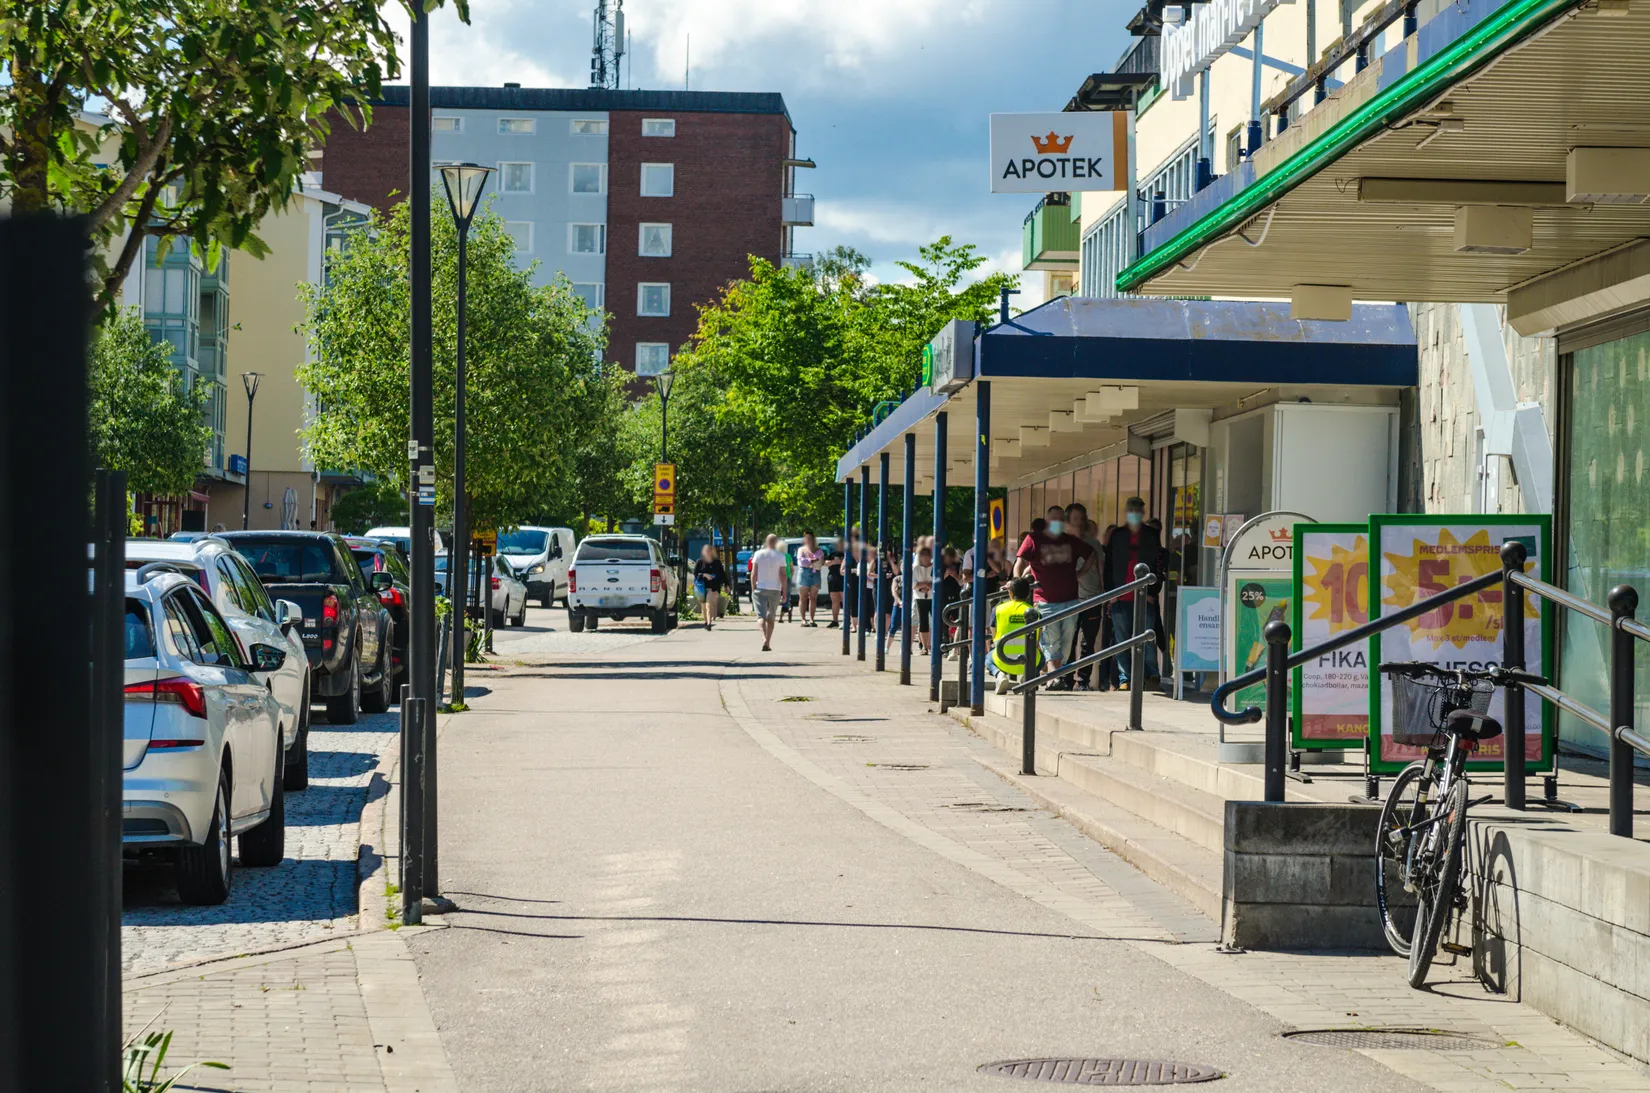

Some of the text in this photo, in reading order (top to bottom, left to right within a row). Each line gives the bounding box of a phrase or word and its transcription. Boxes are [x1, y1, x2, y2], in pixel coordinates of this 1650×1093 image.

[1003, 157, 1103, 179] APOTEK
[1419, 545, 1501, 555] MEDLEMSPRIS
[1242, 591, 1264, 601] 25%
[1426, 634, 1496, 642] Max 3 st/medlem
[1319, 651, 1367, 668] FIKA
